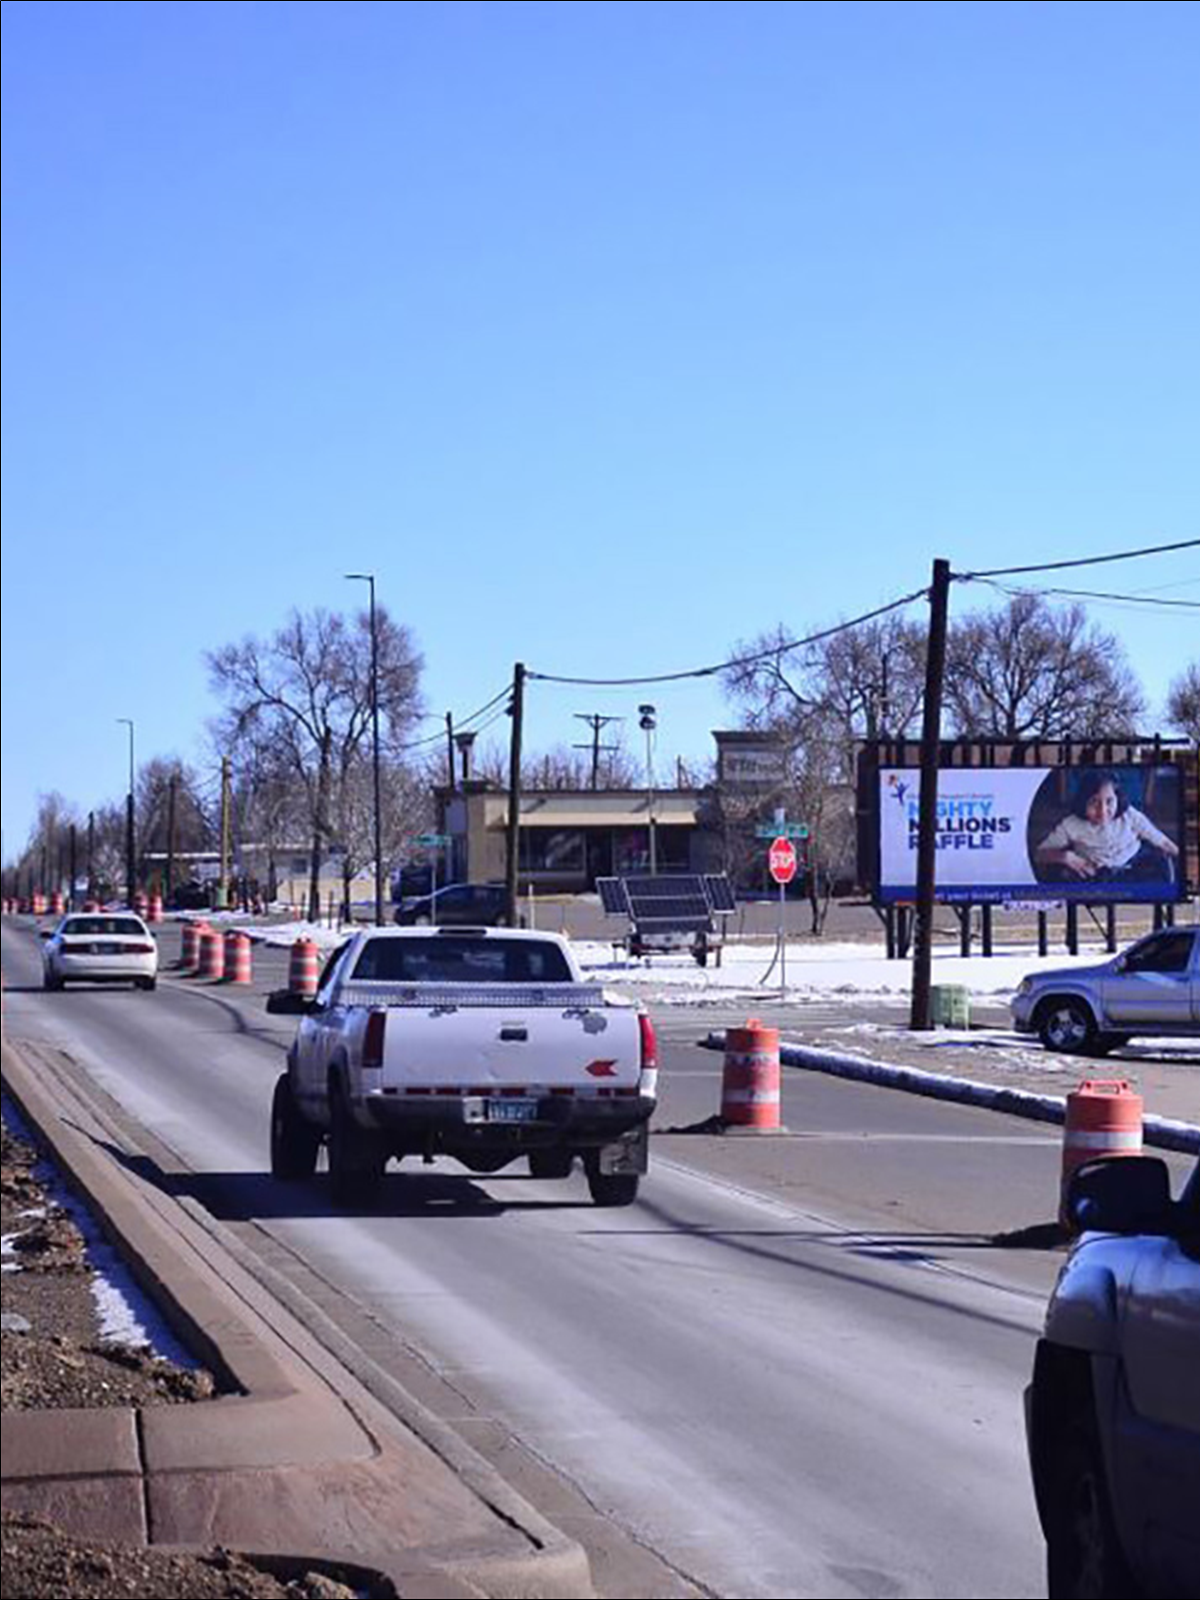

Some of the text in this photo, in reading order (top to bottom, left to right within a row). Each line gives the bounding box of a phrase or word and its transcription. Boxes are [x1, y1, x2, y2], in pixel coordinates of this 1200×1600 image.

[908, 801, 992, 817] MGHTY
[908, 818, 1011, 833] MLLIONS
[908, 834, 994, 850] RFFLE
